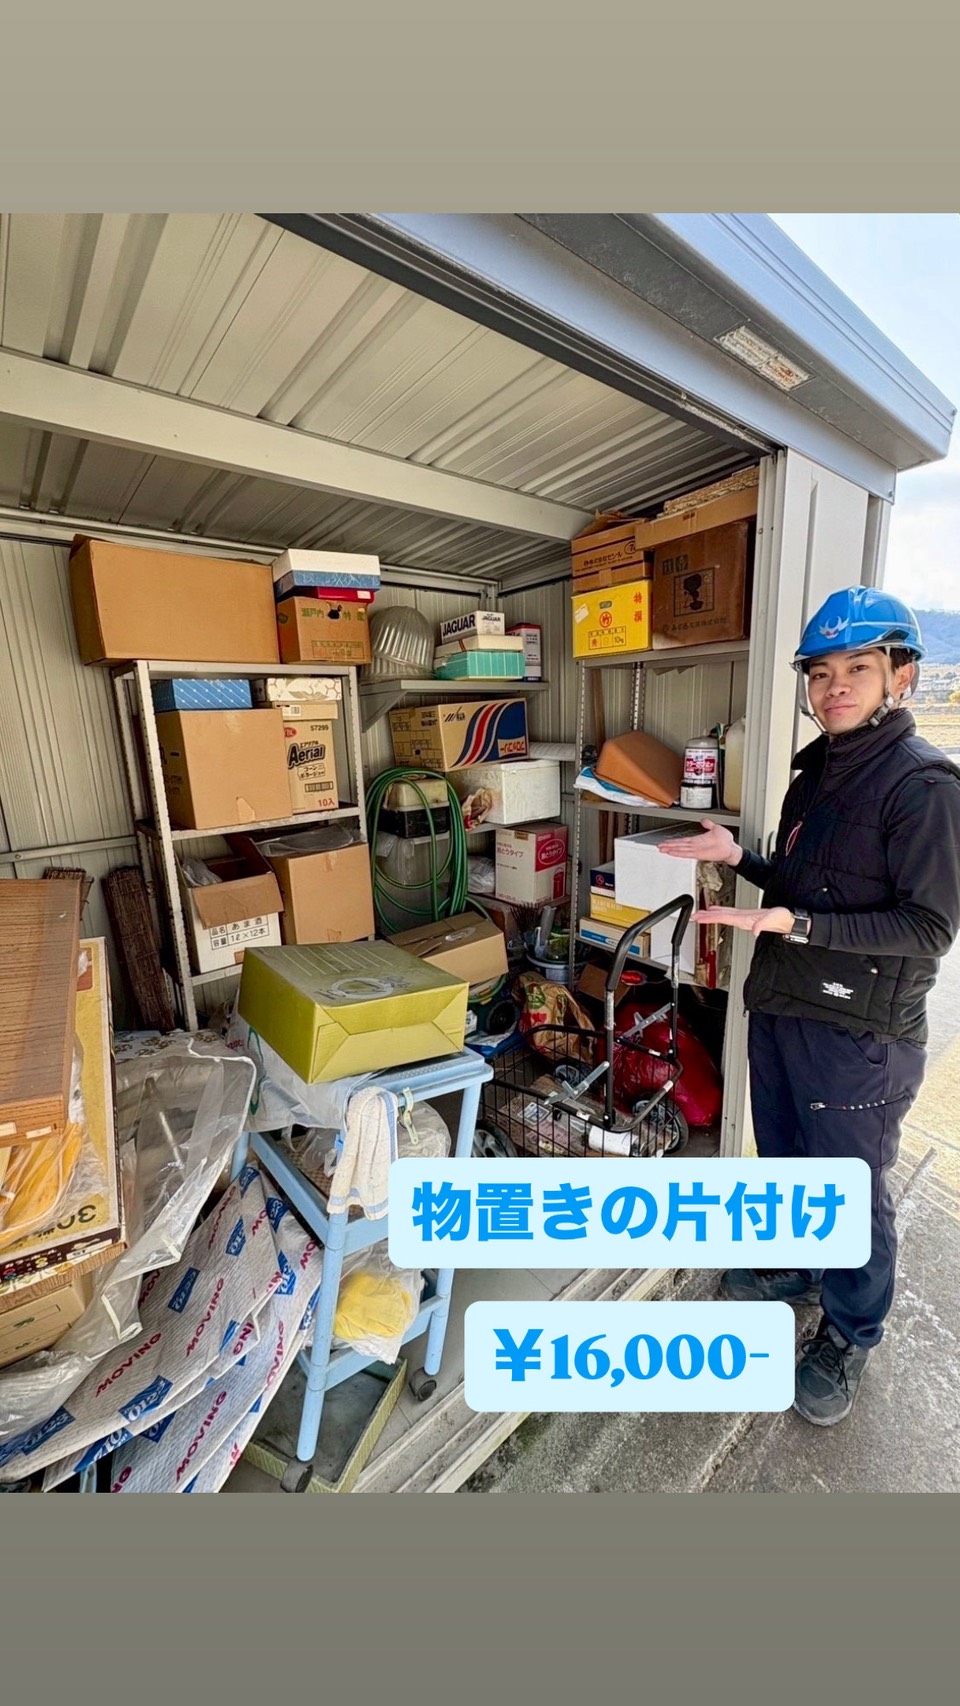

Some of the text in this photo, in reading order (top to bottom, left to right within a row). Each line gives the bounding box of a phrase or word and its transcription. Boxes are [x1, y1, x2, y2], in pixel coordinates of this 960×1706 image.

[443, 613, 476, 637] JAGUAR
[310, 724, 329, 732] 57299
[288, 743, 324, 768] Aerial
[300, 740, 319, 748] エアリアル
[318, 798, 335, 808] 10入
[212, 917, 262, 936] 品名 あま酒
[213, 937, 227, 947] 容量
[208, 1186, 236, 1249] MOVING
[187, 1278, 225, 1357] MOVING
[96, 1332, 162, 1398] MOVING
[127, 1379, 166, 1422] 0123
[177, 1391, 227, 1482] MOVING
